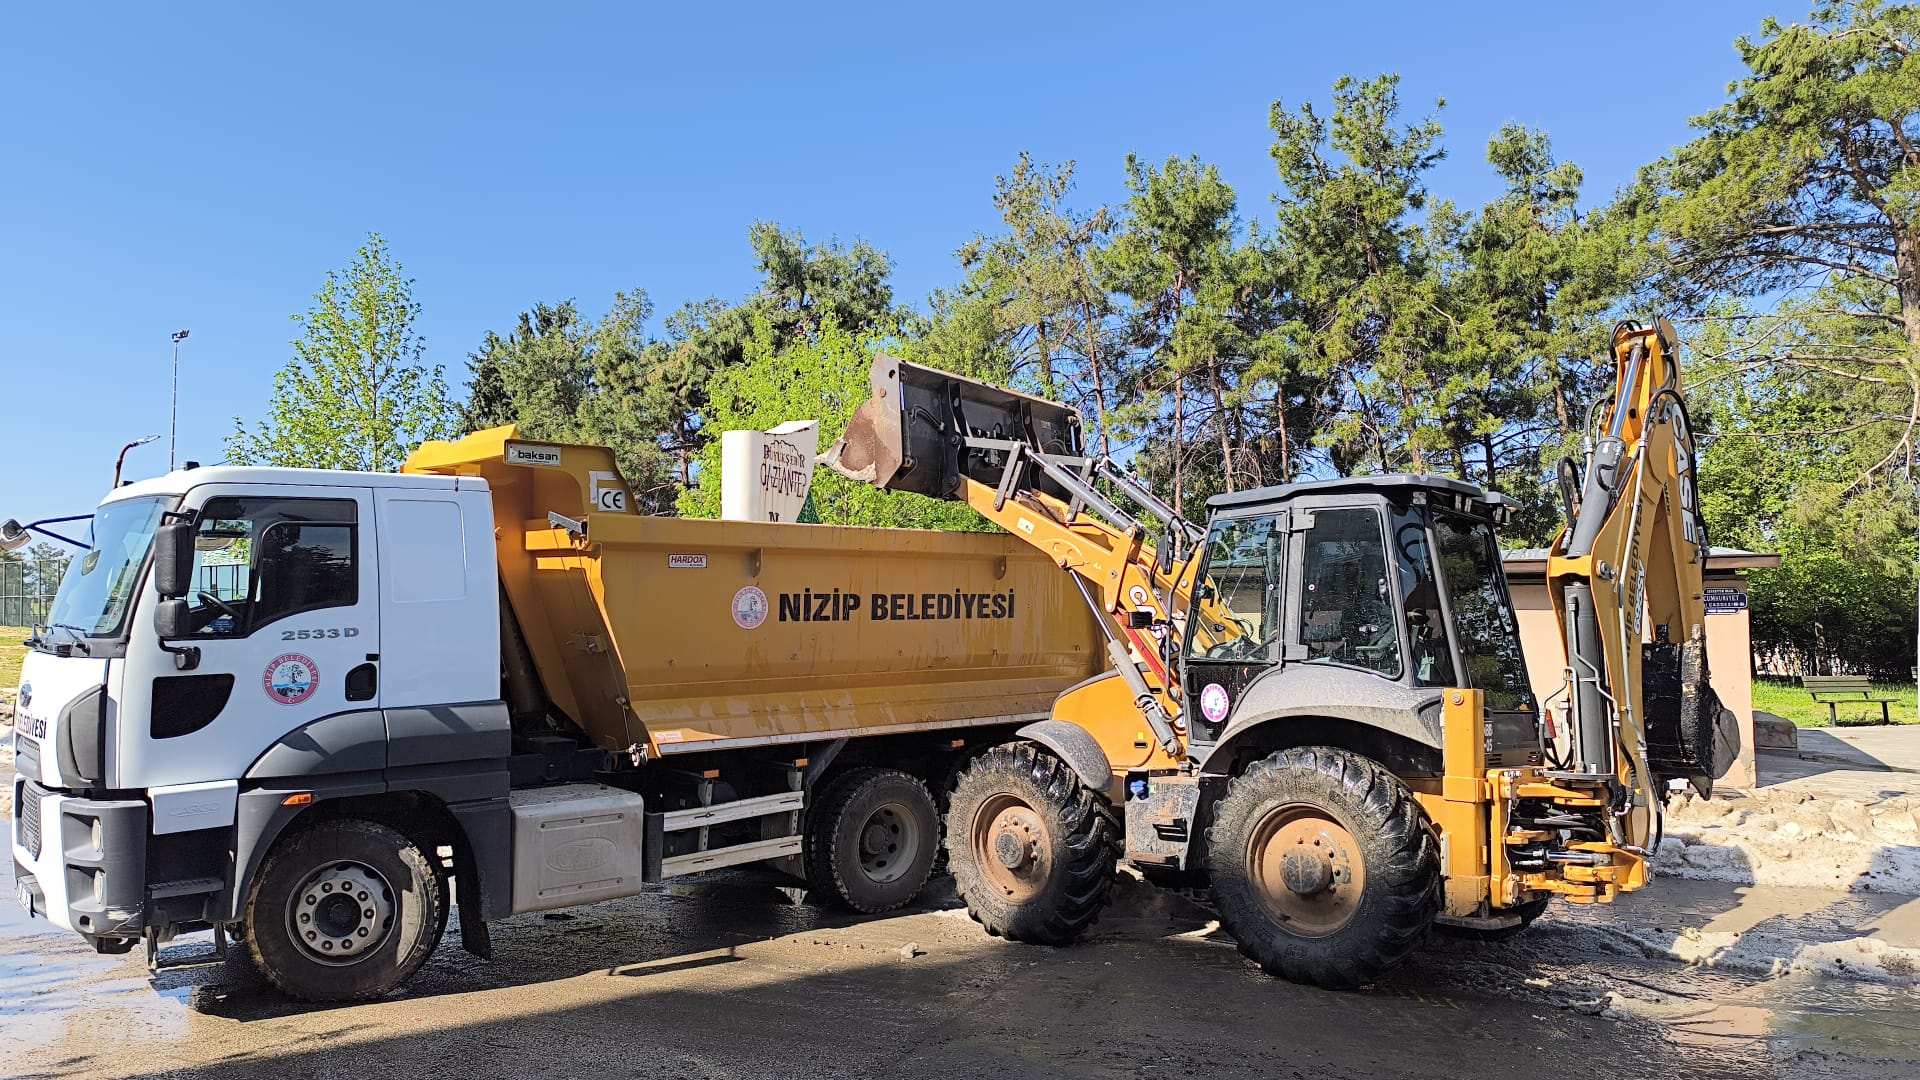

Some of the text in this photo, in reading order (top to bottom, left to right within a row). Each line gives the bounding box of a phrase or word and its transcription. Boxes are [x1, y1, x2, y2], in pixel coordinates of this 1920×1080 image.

[518, 450, 558, 461] baksan
[1671, 402, 1697, 545] CASE
[602, 491, 623, 509] CE
[779, 588, 861, 621] NİZİP
[871, 588, 1015, 620] BELEDİYESİ
